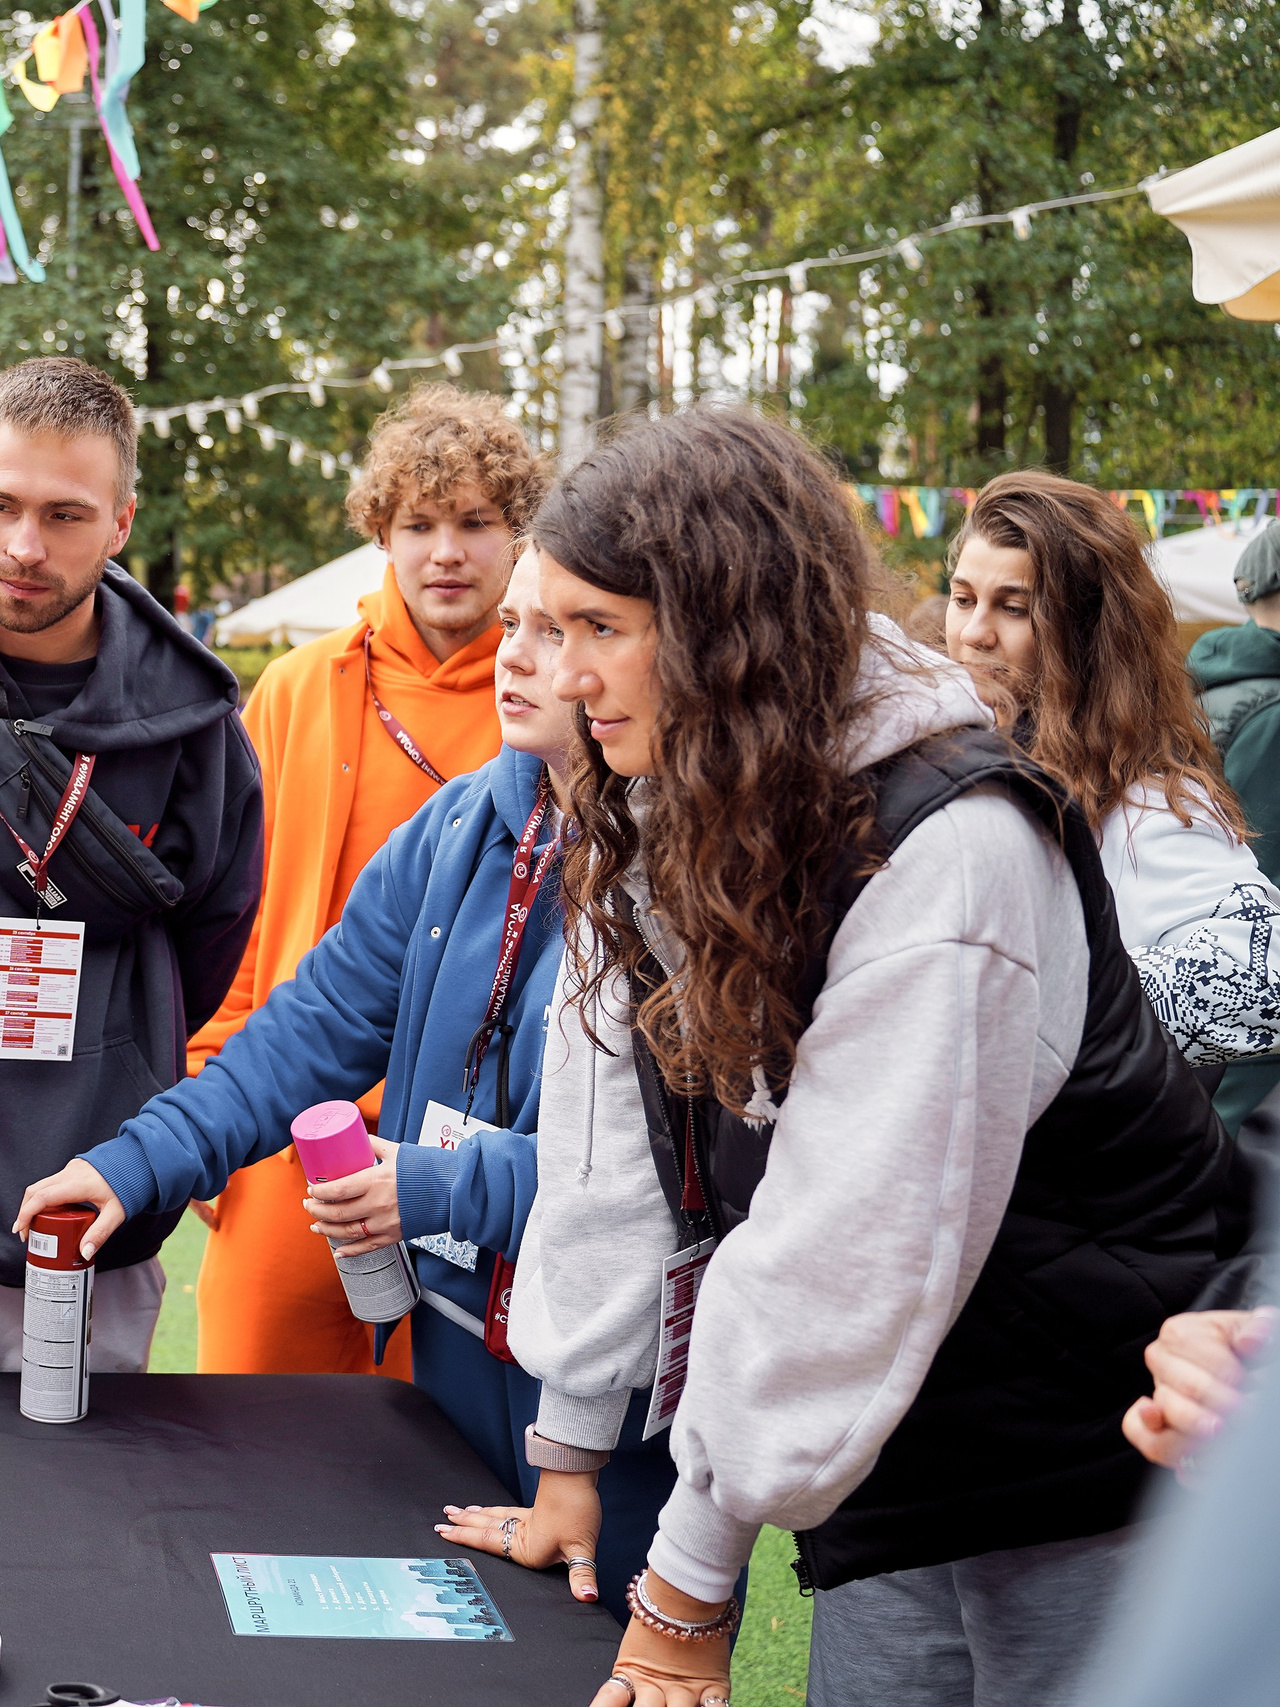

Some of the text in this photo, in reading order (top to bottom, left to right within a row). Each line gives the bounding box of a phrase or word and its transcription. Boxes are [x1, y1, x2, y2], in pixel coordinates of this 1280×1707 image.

[82, 754, 91, 763] Я
[396, 730, 423, 765] ГОРОДА
[59, 762, 89, 823] ФУНДАМЕНТ
[520, 846, 527, 854] Я
[232, 1556, 270, 1633] МАРШРУТНЫЙ ЛИСТ
[290, 1584, 304, 1606] КОМАНДА
